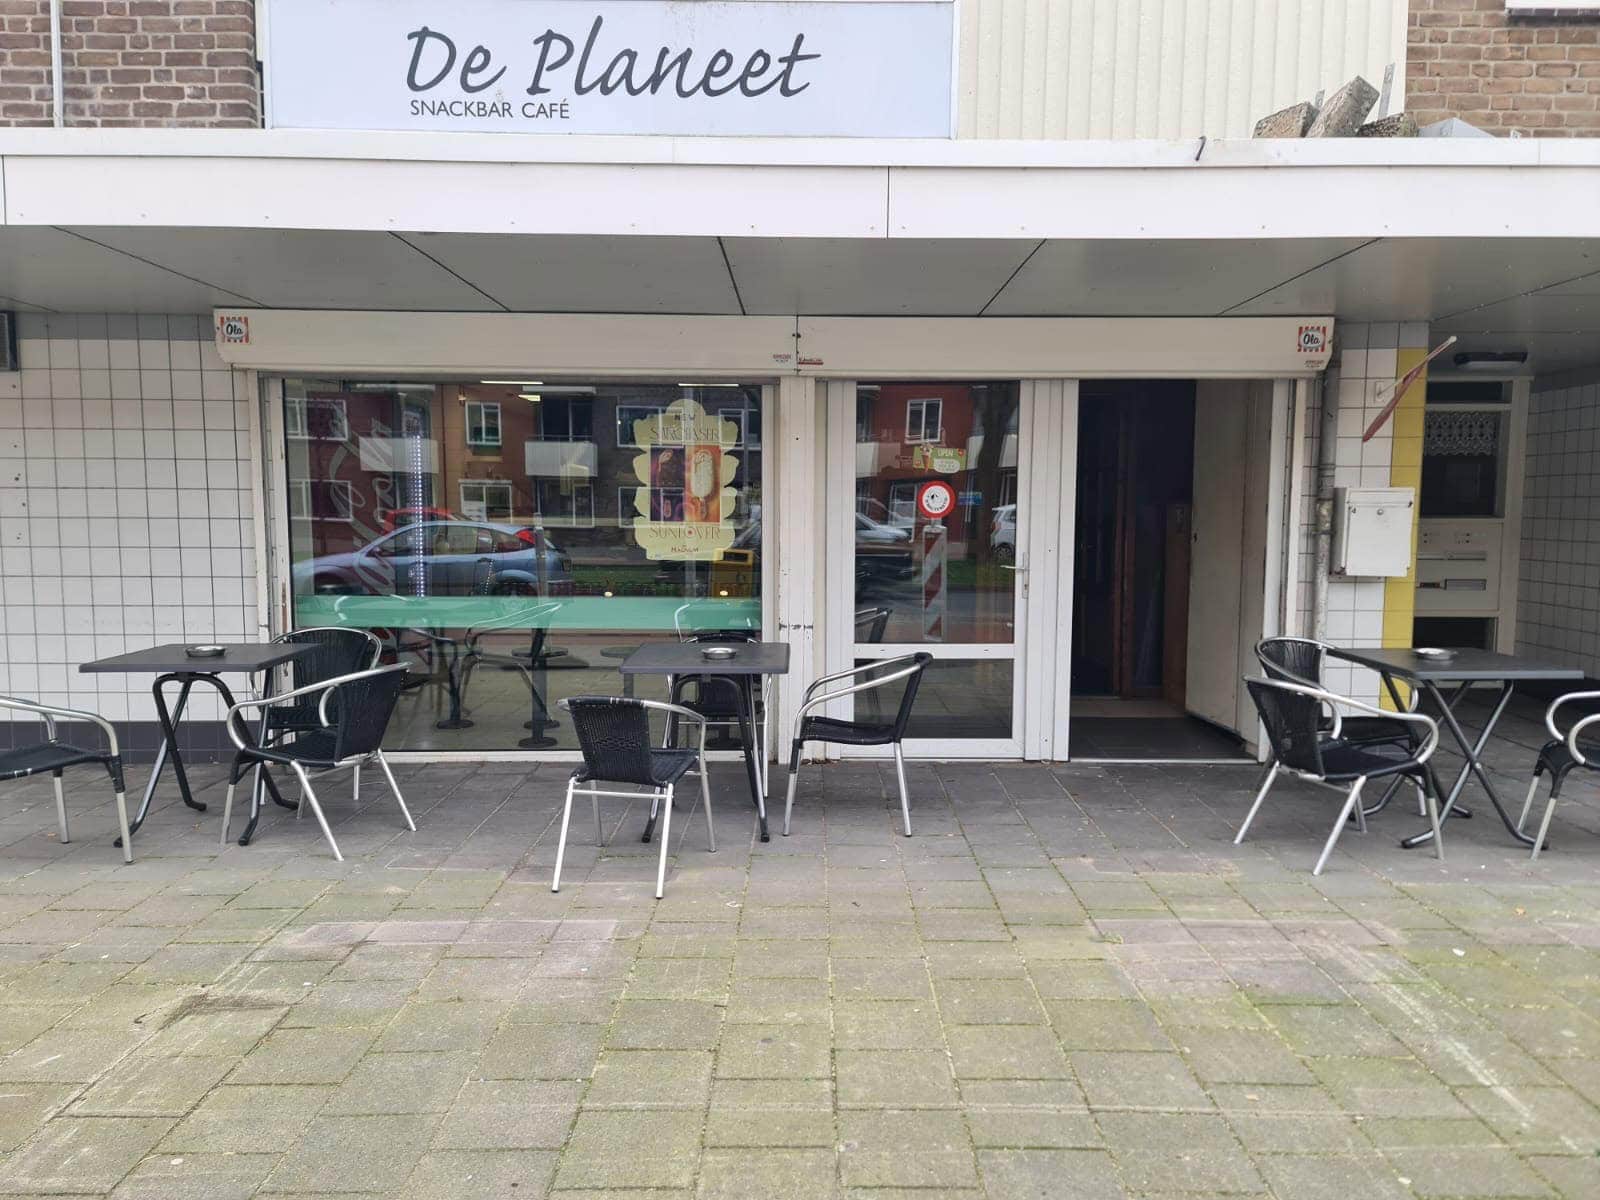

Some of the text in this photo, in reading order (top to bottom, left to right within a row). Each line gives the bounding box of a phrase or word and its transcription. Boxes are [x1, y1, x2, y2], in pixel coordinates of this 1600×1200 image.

[407, 15, 821, 98] De Planeet
[410, 98, 569, 119] SNACKBAR CAFÉ
[226, 323, 243, 336] Ola
[1303, 333, 1320, 345] Ola
[674, 413, 696, 421] NEW
[937, 448, 953, 456] OPEN
